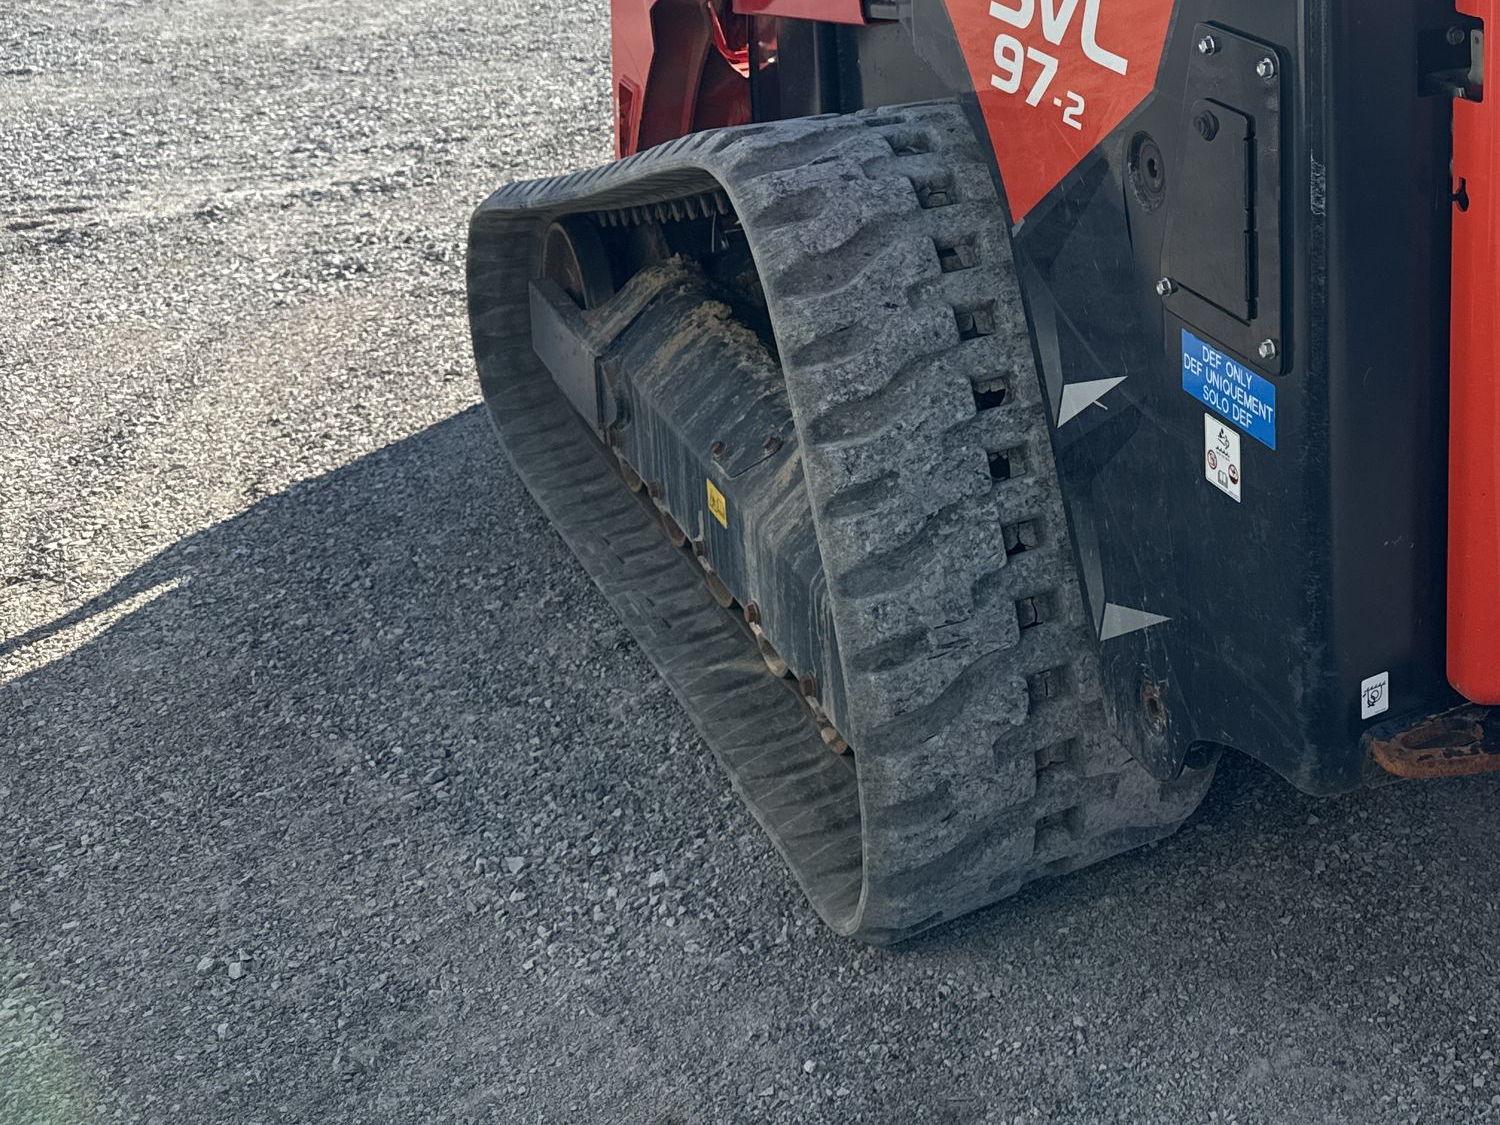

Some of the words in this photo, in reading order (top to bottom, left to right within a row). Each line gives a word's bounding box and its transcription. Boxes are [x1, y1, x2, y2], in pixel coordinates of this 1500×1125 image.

[1184, 353, 1203, 376] DEF
[1205, 366, 1274, 423] UNIQUEMENT
[1202, 346, 1222, 369] DEF
[1225, 362, 1252, 390] ONLY
[1203, 386, 1229, 414] SOLO
[1232, 404, 1252, 428] DEF
